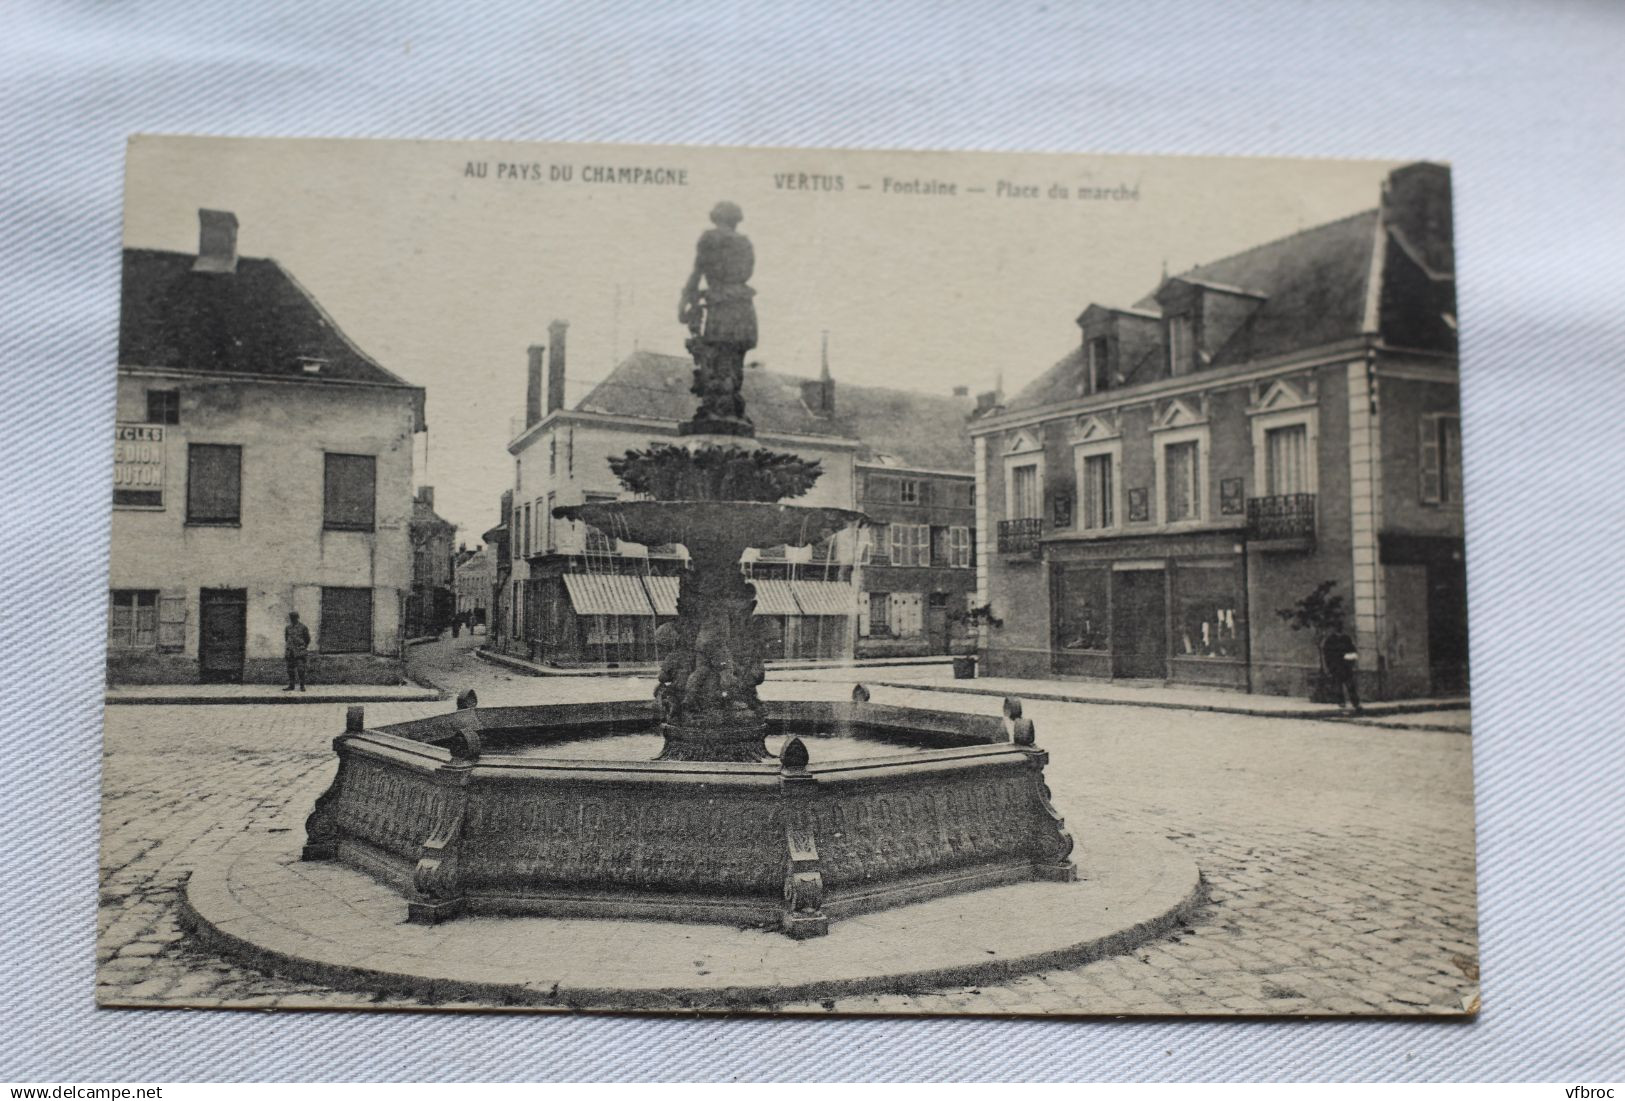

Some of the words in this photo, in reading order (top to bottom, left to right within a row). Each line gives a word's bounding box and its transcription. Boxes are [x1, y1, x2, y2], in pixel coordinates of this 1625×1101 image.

[464, 161, 487, 178] AU
[497, 163, 541, 181] PAYS
[550, 164, 573, 182] DU
[581, 165, 688, 186] CHAMPAGNE
[774, 173, 845, 192] VERTUS
[882, 176, 957, 196] Fontaine
[996, 179, 1039, 198] Place
[1047, 182, 1069, 200] du
[1077, 178, 1139, 201] marché
